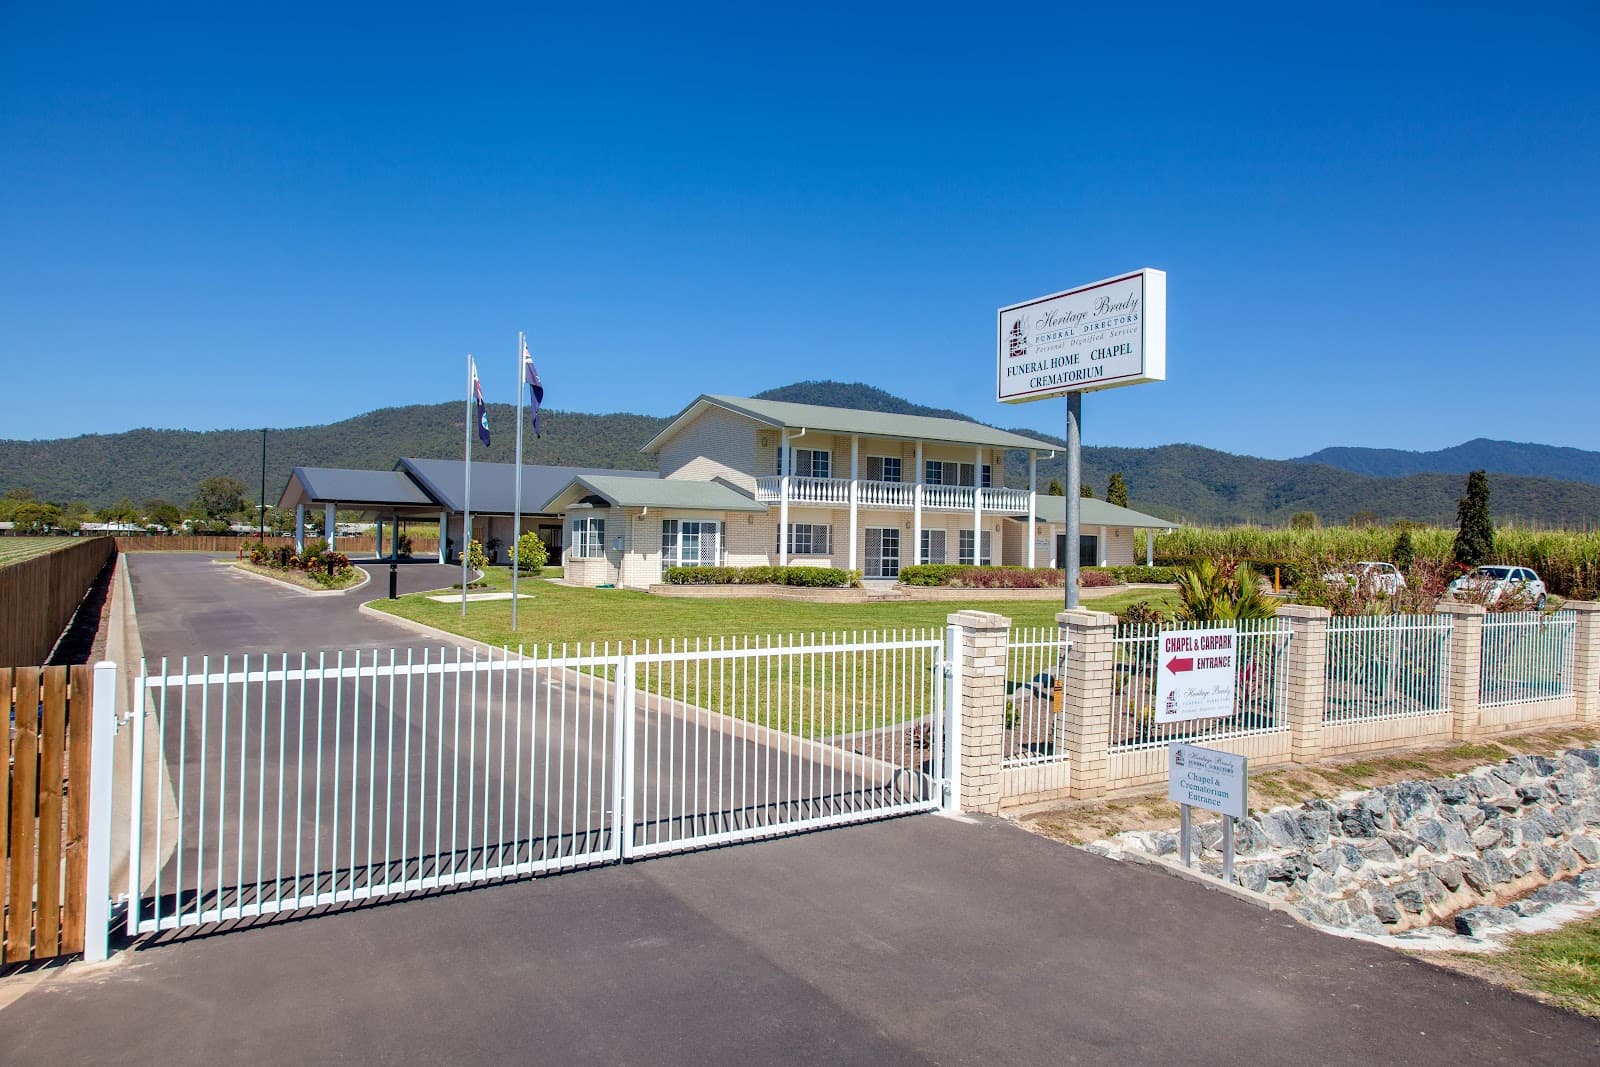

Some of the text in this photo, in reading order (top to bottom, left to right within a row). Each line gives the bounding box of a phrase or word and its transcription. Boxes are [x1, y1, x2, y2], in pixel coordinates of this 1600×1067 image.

[1036, 291, 1139, 330] Heritage Brady
[1035, 314, 1138, 343] FUNERAL DIRECTORS
[1035, 327, 1138, 354] Personal Dignified Service
[1007, 343, 1133, 377] FUNERAL HOME CHAPEL
[1030, 365, 1103, 388] CREMATORIUM
[1165, 635, 1232, 653] CHAPEL & CARPARK
[1197, 656, 1231, 670] ENTRANCE
[1180, 780, 1229, 798] Crematorium
[1187, 772, 1213, 785] Chapel
[1214, 779, 1220, 787] &
[1188, 791, 1221, 806] Entrance
